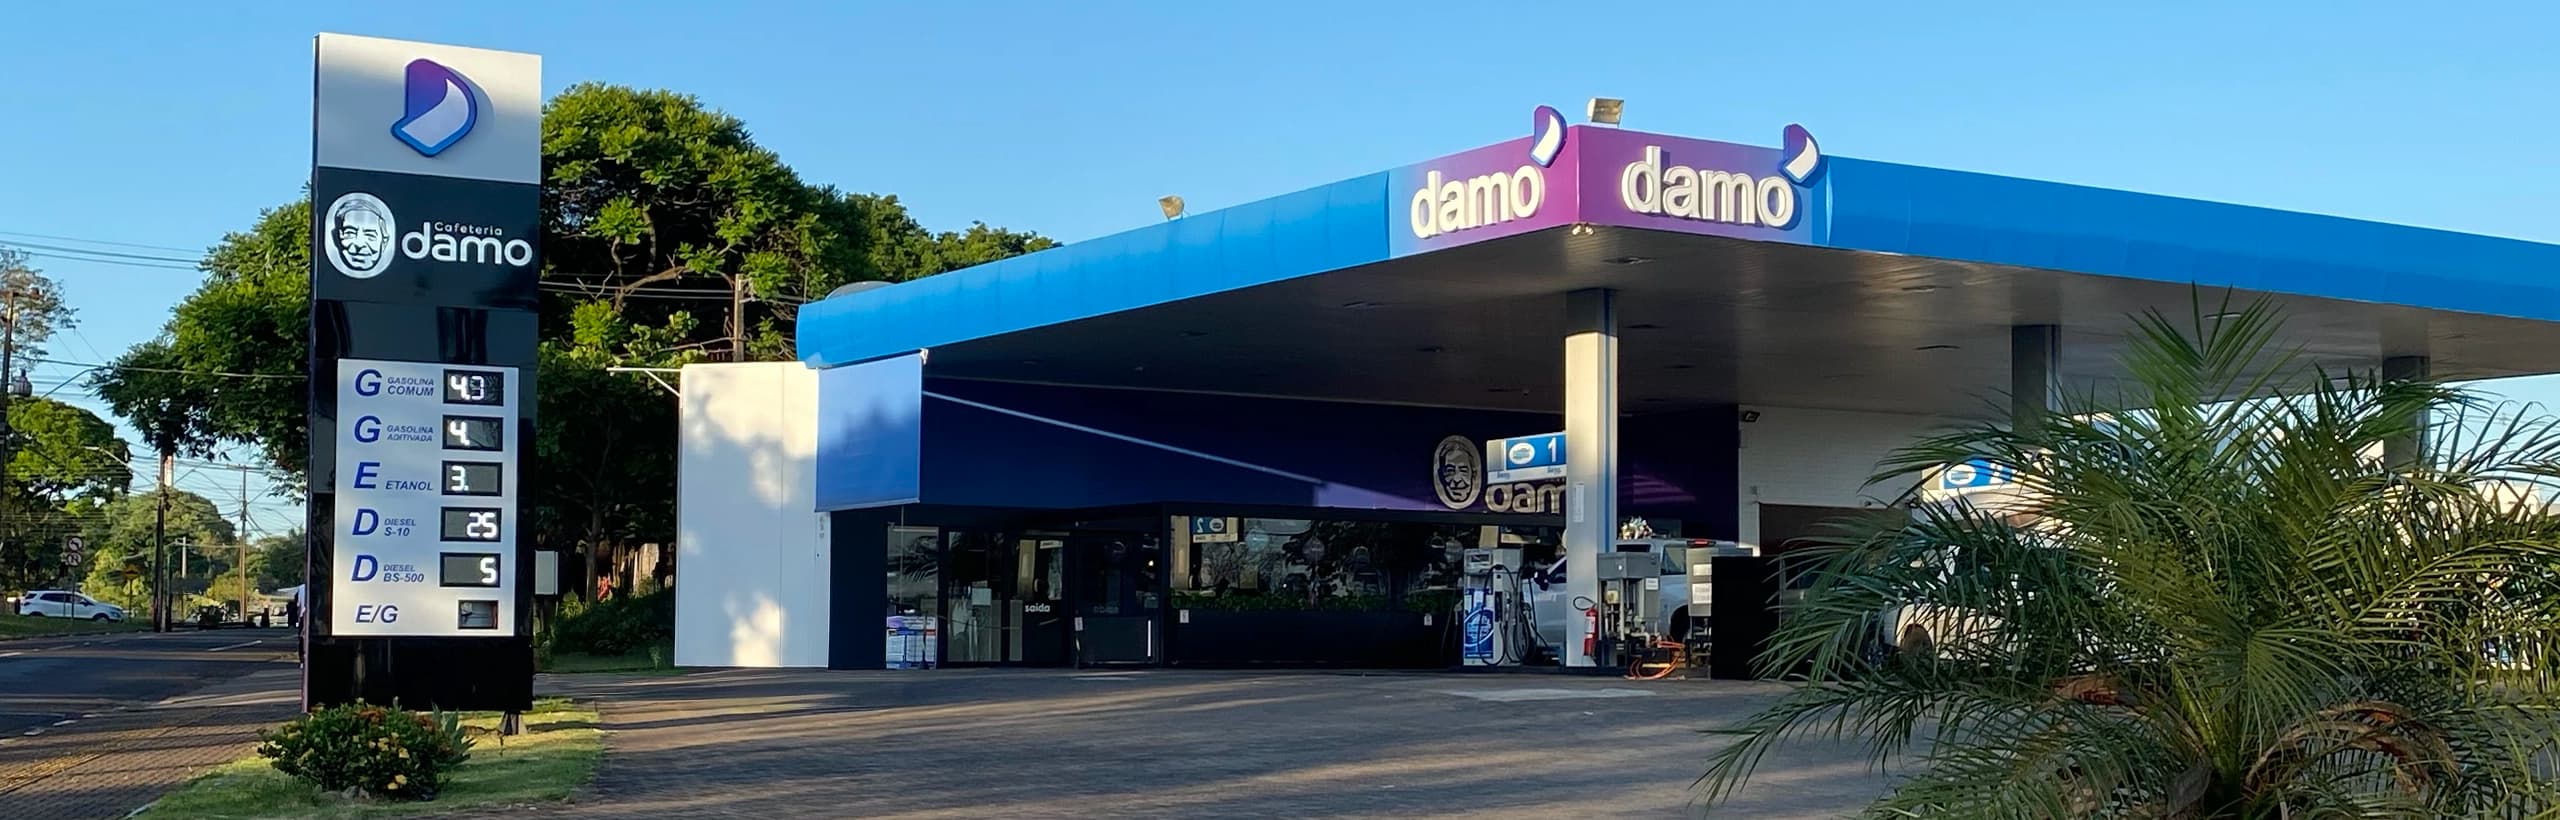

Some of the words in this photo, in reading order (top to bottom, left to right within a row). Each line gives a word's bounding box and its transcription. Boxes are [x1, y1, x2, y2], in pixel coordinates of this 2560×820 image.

[1621, 146, 1795, 228] damo
[1410, 164, 1546, 239] damo
[434, 222, 503, 237] Cafeteria
[401, 222, 534, 267] damo
[355, 369, 382, 397] G
[387, 377, 435, 386] GASOLINA
[387, 386, 435, 397] COMUM
[354, 415, 382, 443] G
[386, 425, 434, 434] GASOLINA
[386, 433, 433, 442] ADITIVADA
[1547, 437, 1558, 463] 1
[353, 462, 381, 489] E
[385, 481, 434, 491] ETANOL
[352, 508, 379, 536] D
[384, 518, 416, 526] DIESEL
[384, 527, 410, 537] S-10
[466, 512, 498, 538] 25
[351, 555, 379, 582] D
[383, 564, 416, 572] DIESEL
[383, 573, 425, 583] BS-500
[479, 557, 497, 584] 5
[355, 604, 399, 624] E/G
